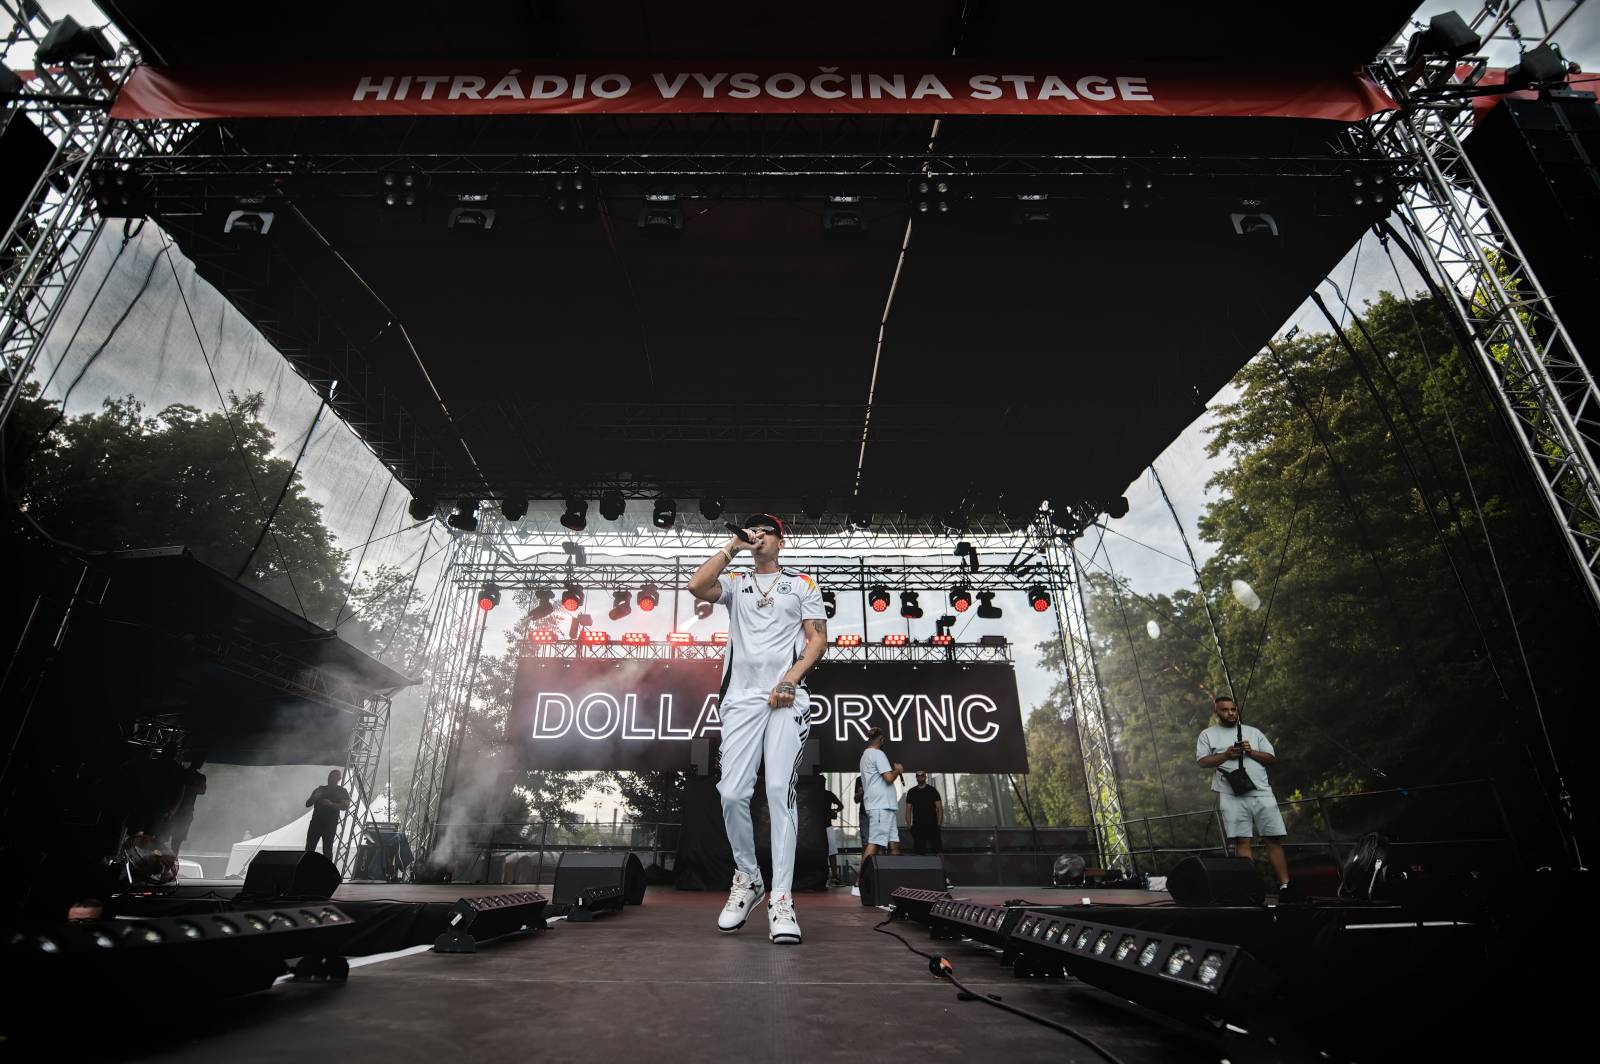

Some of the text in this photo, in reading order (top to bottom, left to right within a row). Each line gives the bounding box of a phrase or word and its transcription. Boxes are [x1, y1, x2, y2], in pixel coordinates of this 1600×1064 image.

[352, 66, 1155, 102] HITRÁDIO VYSOČINA STAGE
[532, 692, 723, 740] DOLLA
